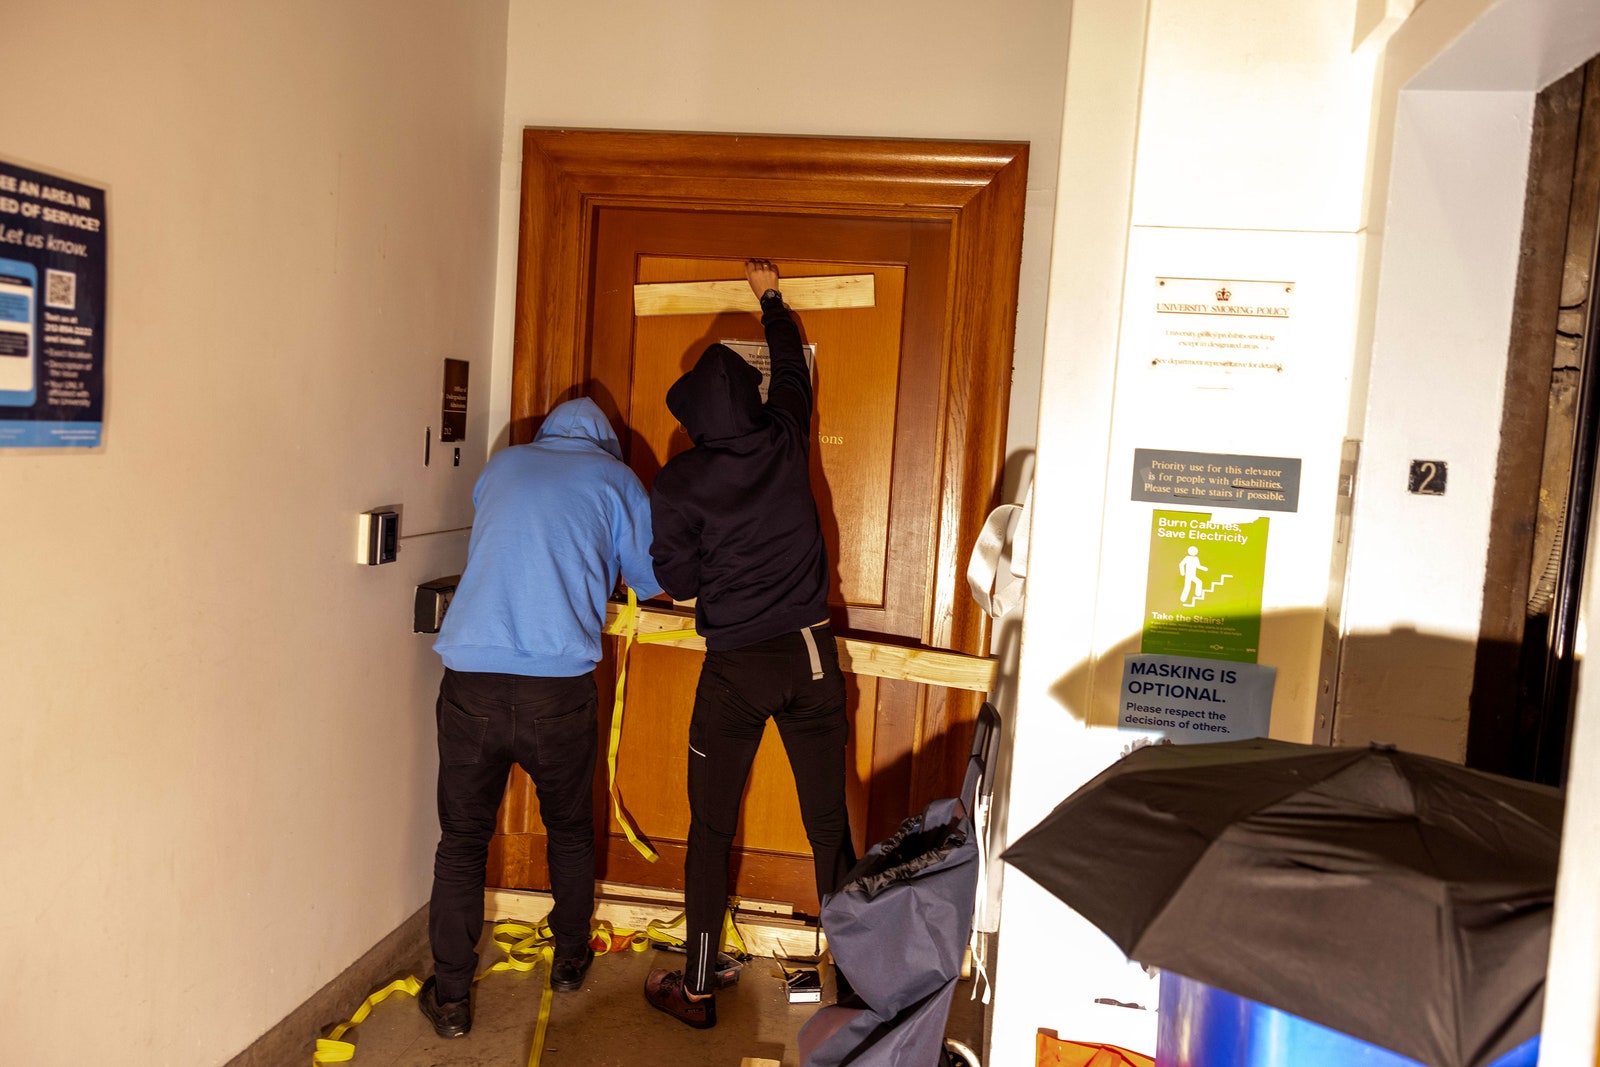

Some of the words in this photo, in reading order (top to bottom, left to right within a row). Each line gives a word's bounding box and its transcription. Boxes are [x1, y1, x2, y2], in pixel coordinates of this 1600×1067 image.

[19, 180, 40, 198] AN
[41, 185, 76, 207] AREA
[76, 194, 91, 210] IN
[21, 202, 41, 219] OF
[42, 207, 101, 232] SERVICE?
[0, 223, 24, 245] Let
[25, 233, 44, 250] us
[46, 233, 88, 257] know.
[1156, 303, 1209, 312] UNIVERSITY
[1211, 305, 1253, 314] SMOKING
[1256, 307, 1290, 316] POLICY
[1152, 460, 1186, 472] Priority
[1189, 464, 1204, 472] use
[1207, 464, 1222, 473] for
[1225, 465, 1242, 475] this
[1245, 467, 1282, 477] elevator
[1419, 462, 1437, 494] 2
[1148, 472, 1156, 480] is
[1158, 472, 1174, 482] for
[1176, 475, 1206, 485] people
[1208, 476, 1230, 486] with
[1232, 478, 1284, 489] disabilities.
[1144, 483, 1171, 494] Please
[1173, 486, 1189, 495] use
[1191, 487, 1206, 496] the
[1208, 489, 1233, 498] stairs
[1235, 490, 1245, 499] if
[1247, 491, 1286, 502] possible.
[1158, 517, 1187, 528] Burn
[1157, 527, 1186, 539] Save
[1188, 529, 1249, 545] Electricity
[1152, 611, 1174, 621] Take
[1176, 614, 1191, 622] the
[1193, 615, 1225, 625] Stairs!
[1130, 662, 1215, 682] MASKING
[1219, 669, 1237, 684] IS
[1128, 680, 1226, 703] OPTIONAL.
[1126, 702, 1162, 714] Please
[1164, 706, 1205, 719] respect
[1208, 710, 1226, 721] the
[1125, 714, 1176, 728] decisions
[1178, 718, 1191, 729] of
[1192, 720, 1230, 734] others.
